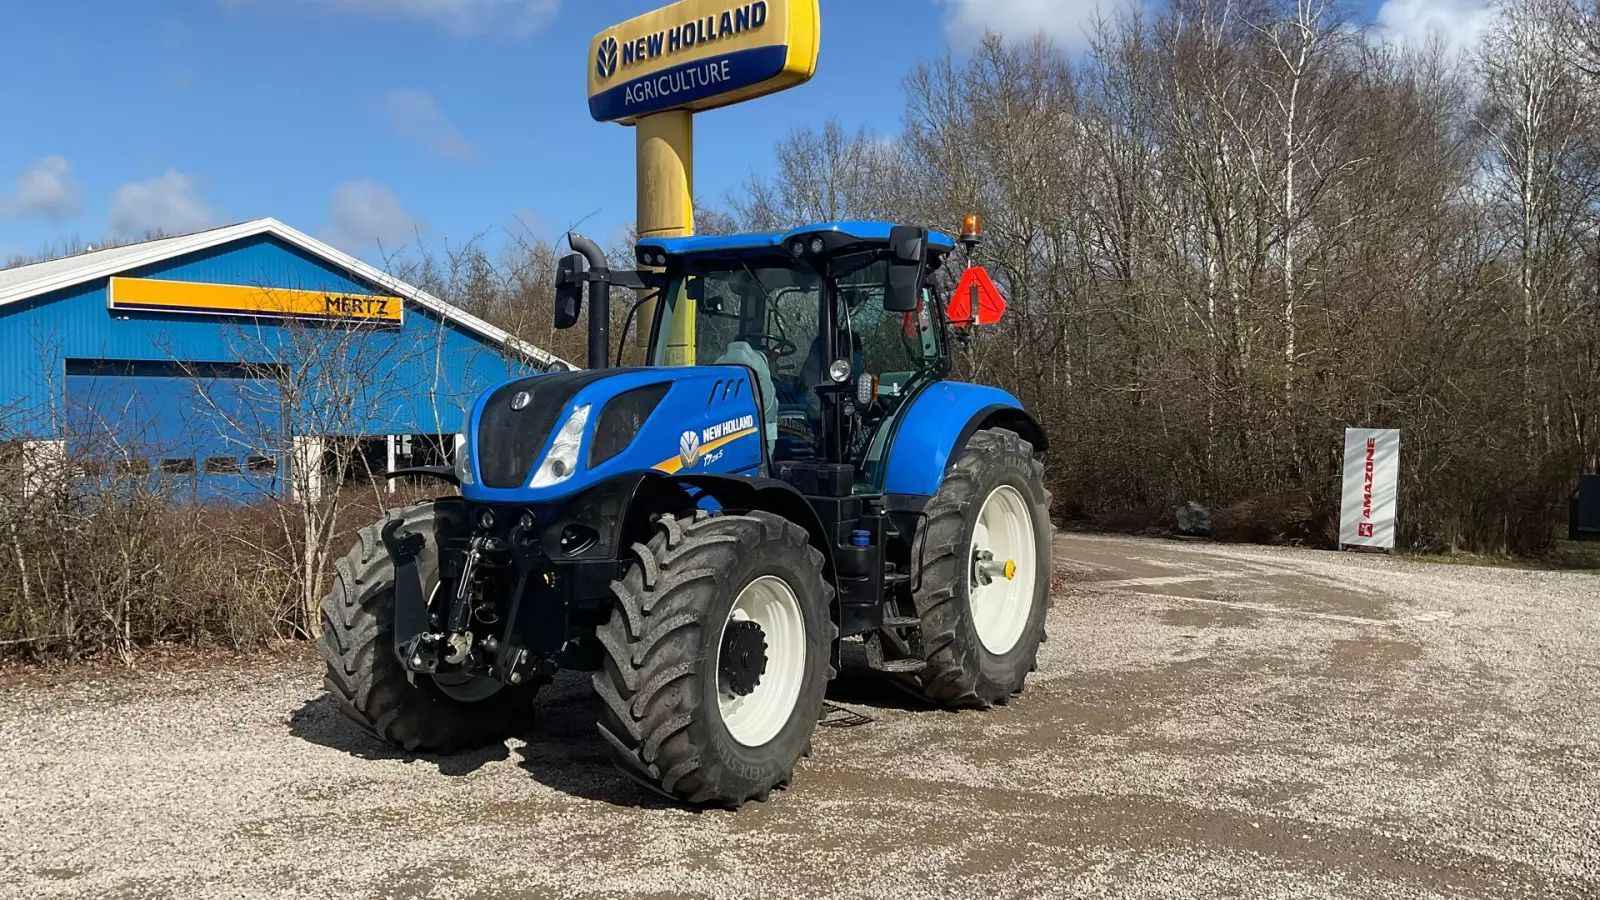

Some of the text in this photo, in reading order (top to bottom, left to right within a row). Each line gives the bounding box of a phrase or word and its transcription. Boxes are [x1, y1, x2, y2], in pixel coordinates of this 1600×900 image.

[623, 1, 767, 64] NEW HOLLAND
[625, 60, 730, 105] AGRICULTURE
[324, 296, 389, 315] MERTZ
[703, 415, 753, 443] NEW HOLLAND
[1363, 438, 1375, 519] AMAZONE
